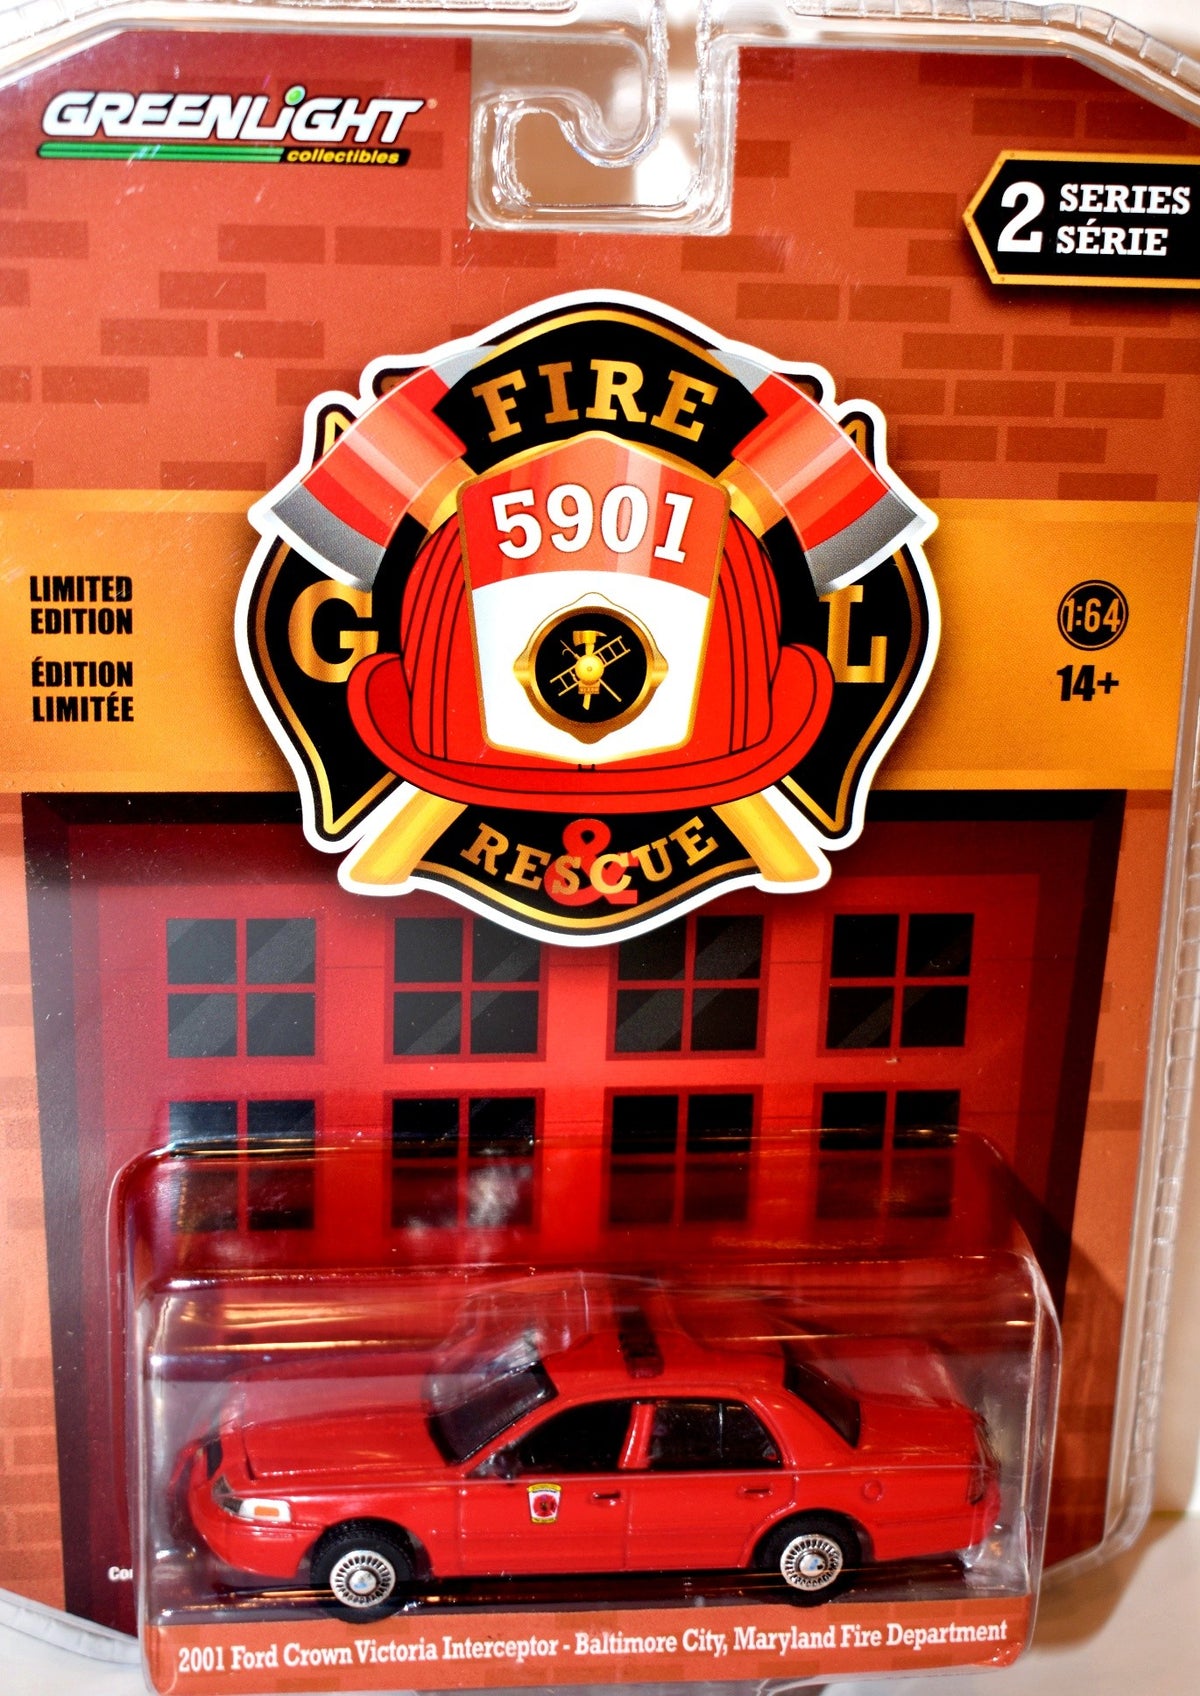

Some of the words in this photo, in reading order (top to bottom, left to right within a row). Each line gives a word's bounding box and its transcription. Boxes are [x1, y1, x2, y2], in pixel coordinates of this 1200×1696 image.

[286, 148, 400, 164] collectibles
[997, 181, 1045, 253] 2
[1059, 183, 1191, 215] SERIES
[1056, 218, 1169, 256] SÉRIE
[471, 358, 719, 443] FIRE
[491, 483, 694, 564] 5901
[30, 575, 133, 602] LIMITED
[31, 608, 133, 635] EDITION
[288, 579, 379, 683] G
[818, 584, 888, 683] L
[1064, 597, 1121, 633] 1:64
[31, 655, 133, 687] ÉDITION
[1056, 664, 1119, 702] 14+
[33, 691, 134, 722] LIMITÉE
[459, 815, 719, 895] RESCUE
[178, 1646, 225, 1673] 2001
[230, 1643, 279, 1670] Ford
[283, 1643, 353, 1668] Crown
[354, 1637, 438, 1664] Victoria
[441, 1634, 559, 1664] Interceptor
[574, 1631, 677, 1655] Baltimore
[682, 1627, 729, 1658] City,
[733, 1625, 836, 1656] Maryland
[840, 1624, 882, 1648] Fire
[886, 1619, 1008, 1651] Department
